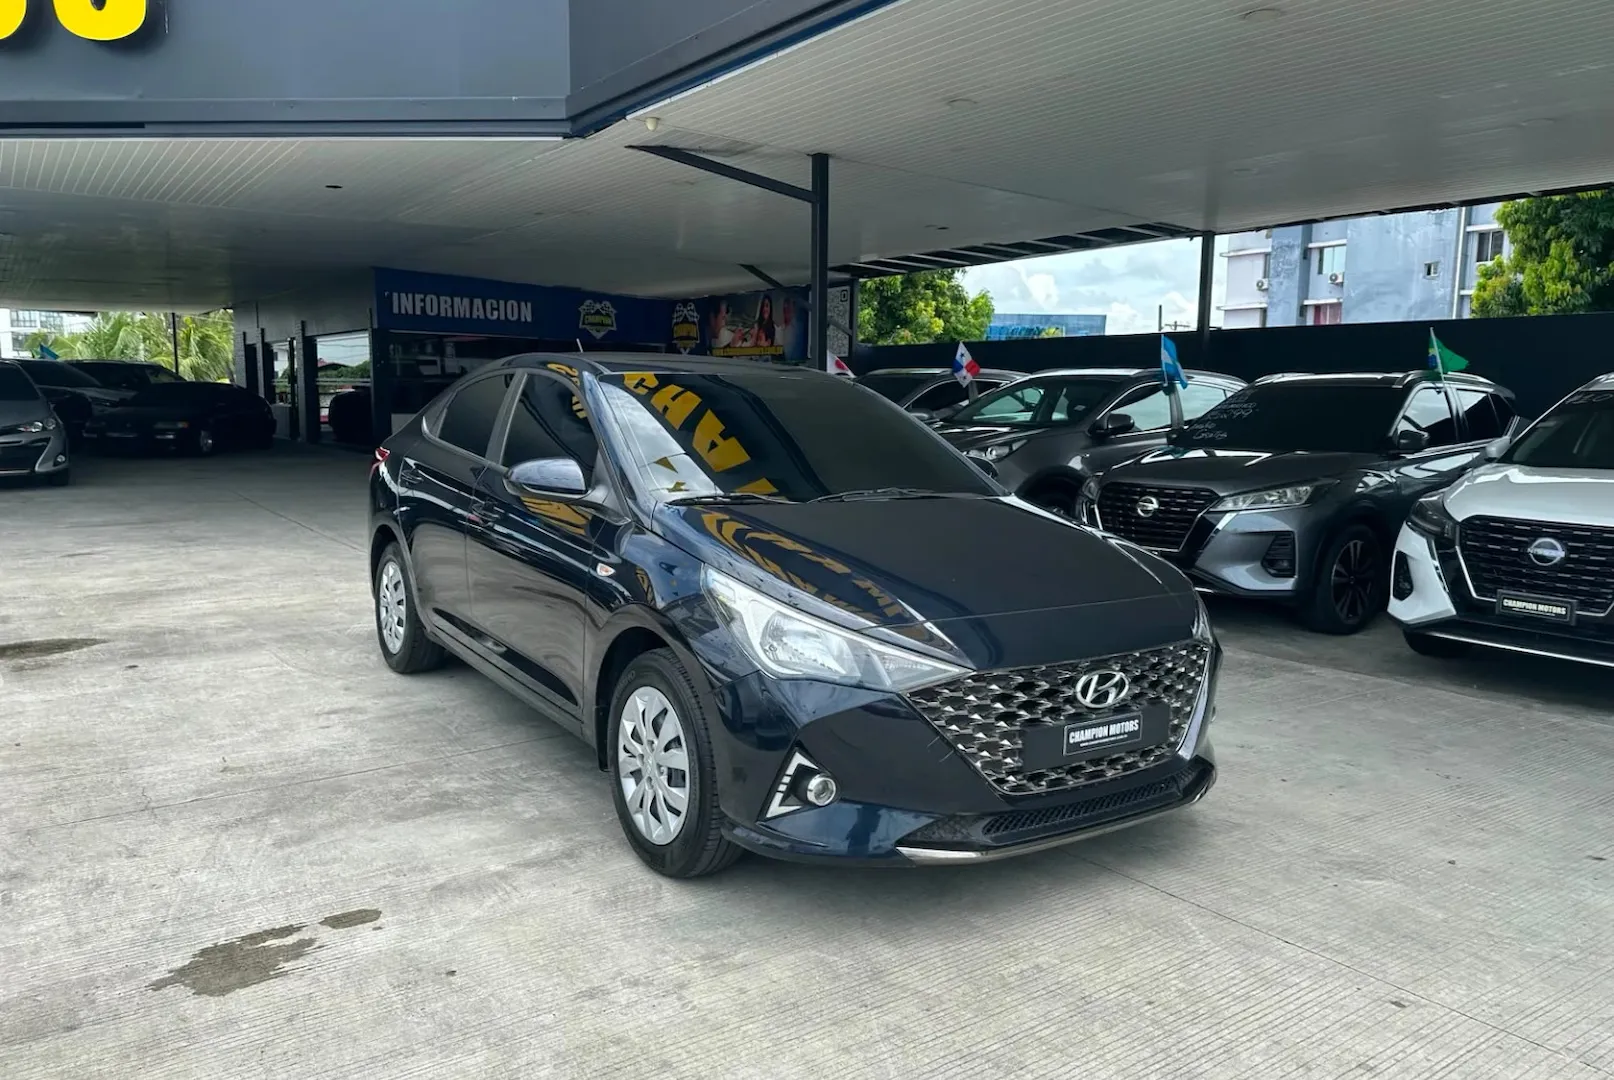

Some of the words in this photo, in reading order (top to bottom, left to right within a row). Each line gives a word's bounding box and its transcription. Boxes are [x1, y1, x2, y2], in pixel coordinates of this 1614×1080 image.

[392, 292, 533, 322] INFORMACION
[1503, 599, 1538, 611] CHAMPION
[1538, 604, 1567, 615] MOTORS
[1069, 726, 1109, 743] CHAMPION
[1109, 720, 1139, 735] MOTORS
